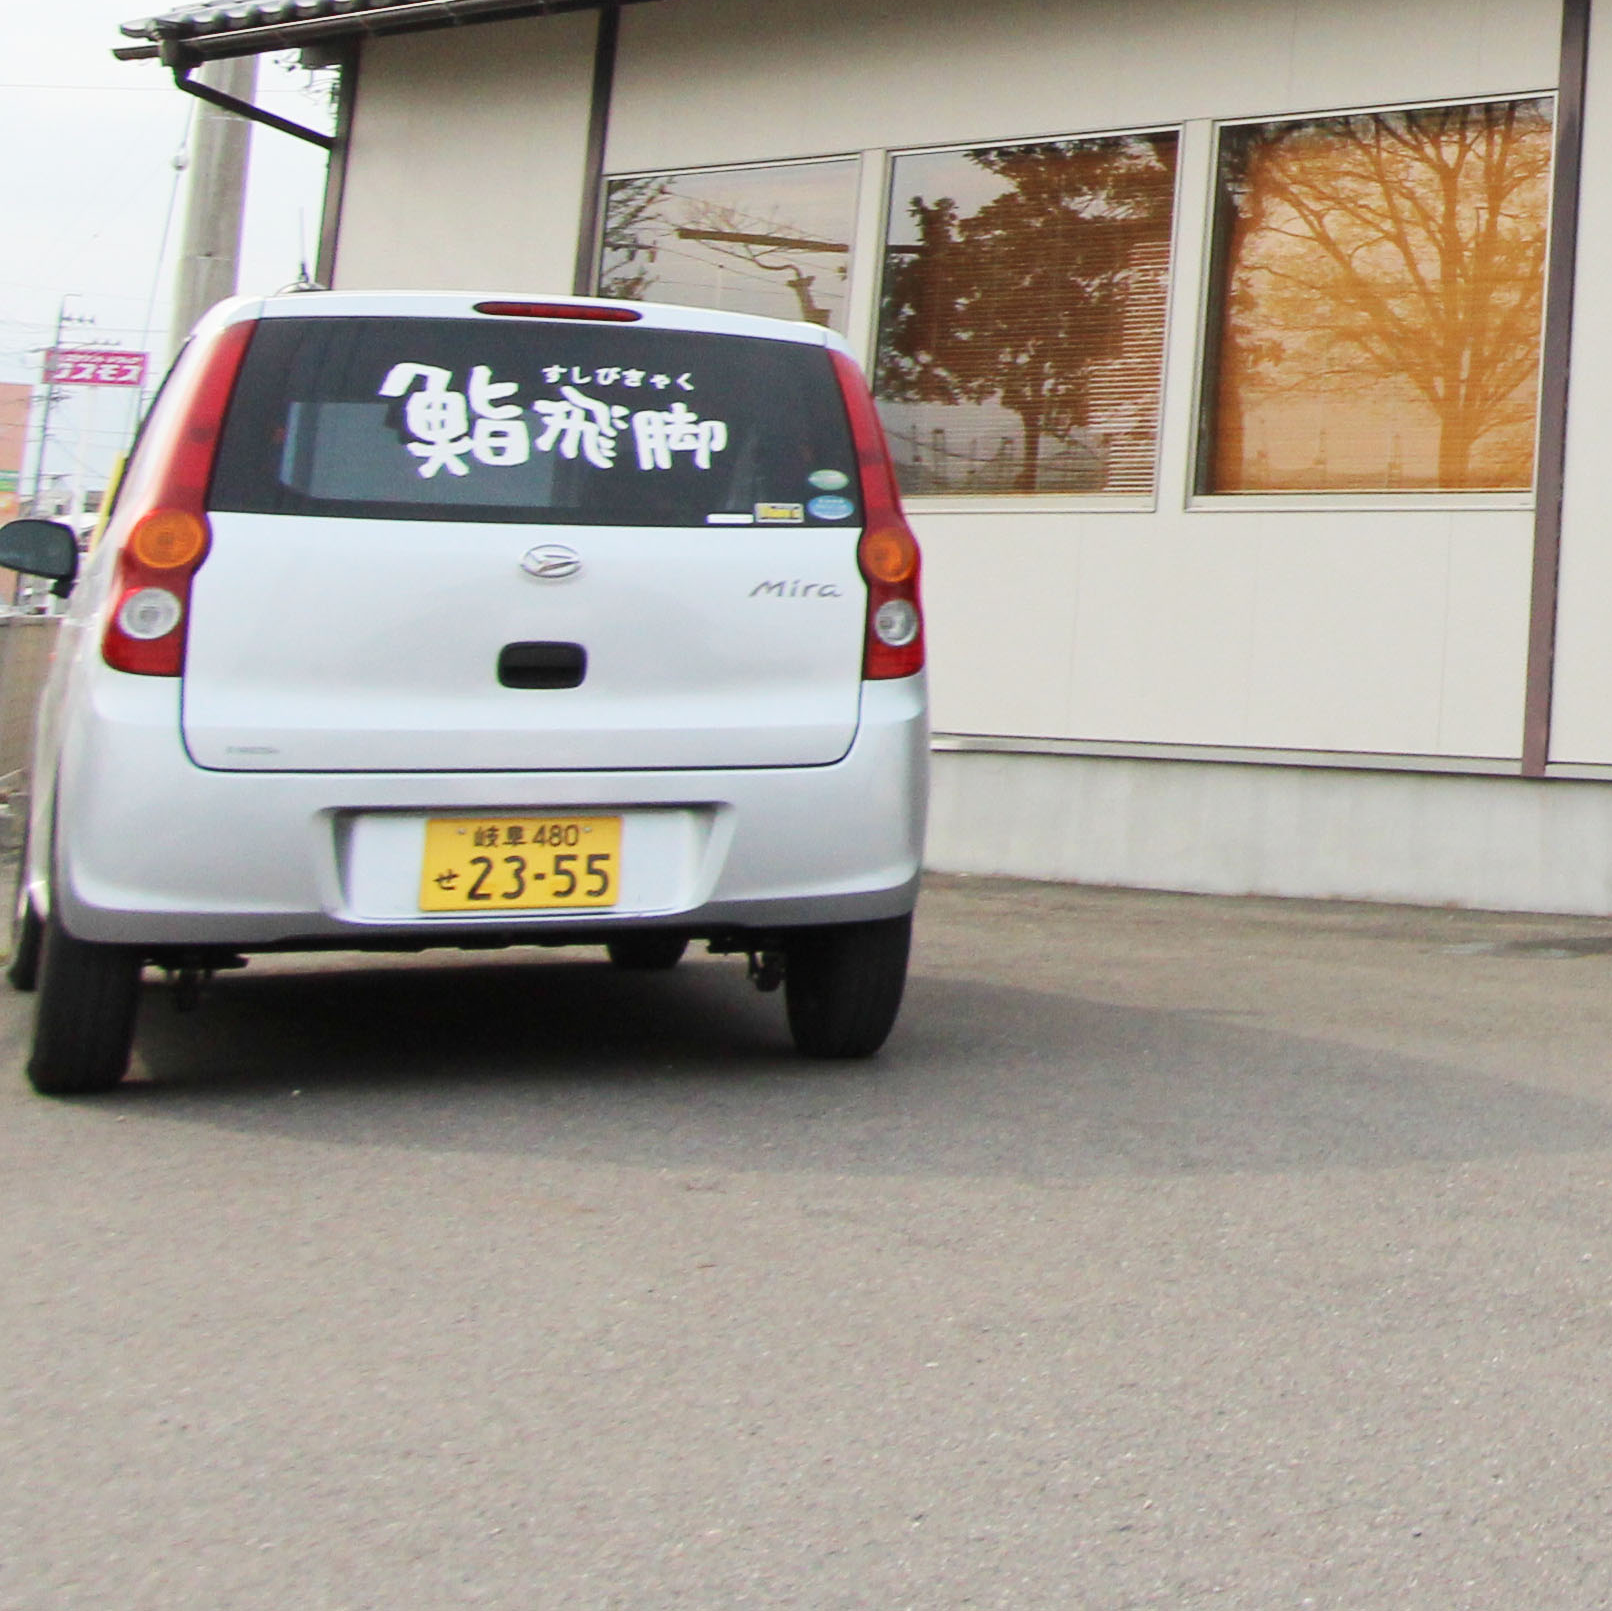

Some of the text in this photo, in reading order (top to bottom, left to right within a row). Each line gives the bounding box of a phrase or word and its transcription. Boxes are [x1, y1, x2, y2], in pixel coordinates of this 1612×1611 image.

[541, 364, 695, 391] すしびきゃく
[378, 362, 728, 479] 鮨飛脚
[749, 578, 842, 598] Mira
[533, 824, 579, 847] 480
[433, 853, 611, 901] せ 23-55
